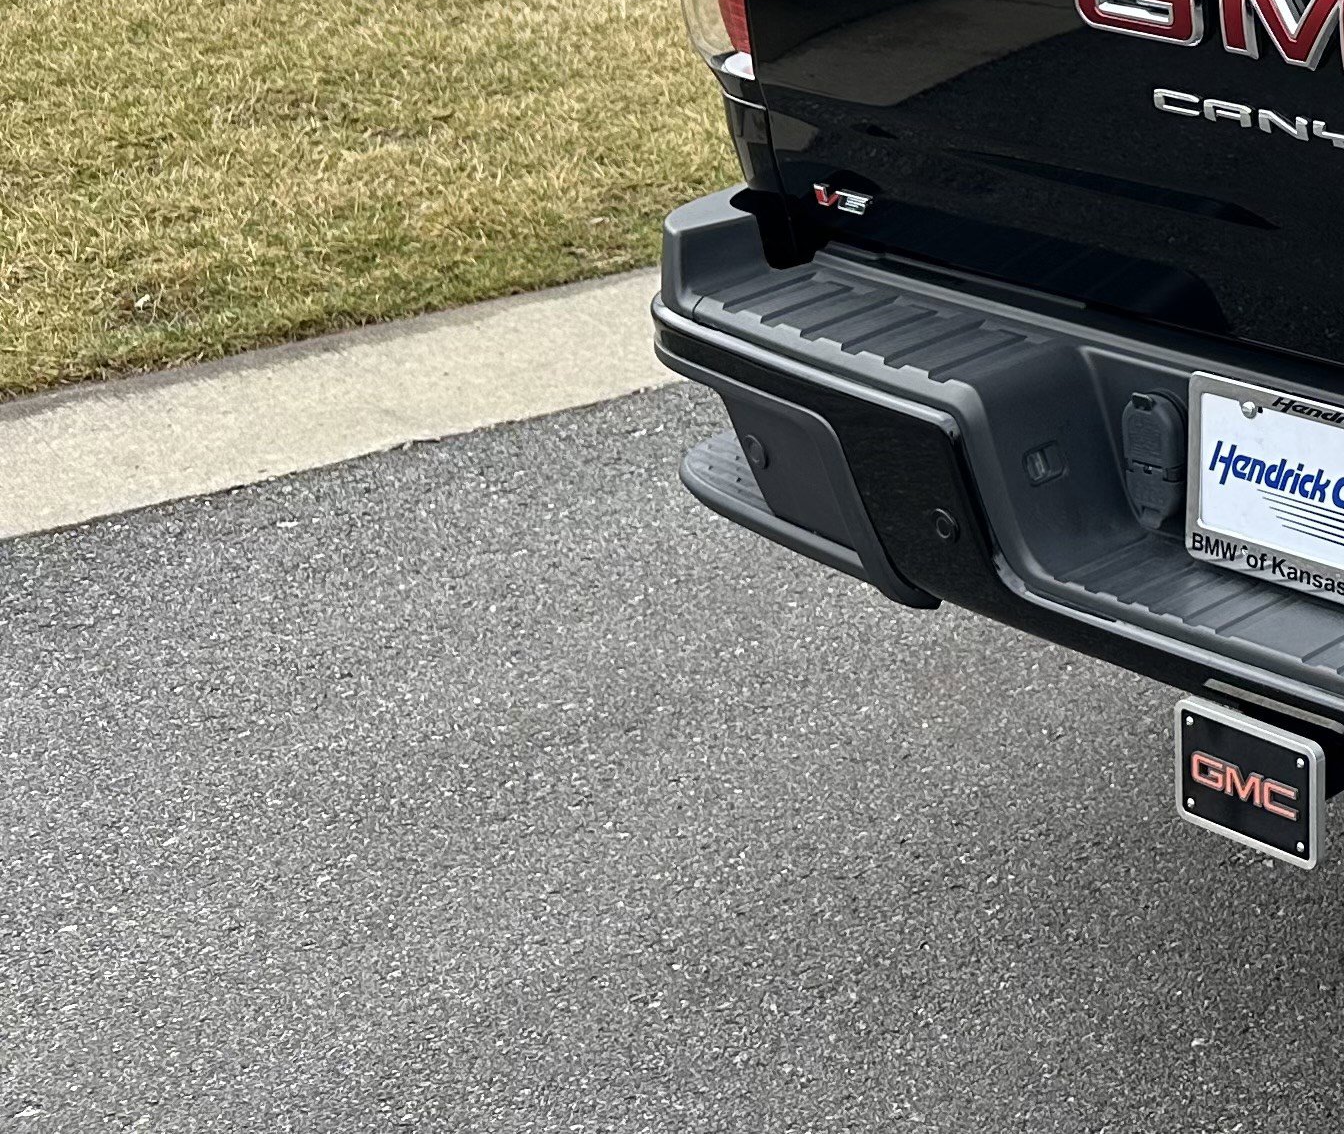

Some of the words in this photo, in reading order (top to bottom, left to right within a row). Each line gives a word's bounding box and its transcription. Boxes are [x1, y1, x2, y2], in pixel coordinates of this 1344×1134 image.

[1191, 532, 1237, 562] BMW
[1246, 550, 1271, 571] of
[1191, 750, 1299, 822] GMC
